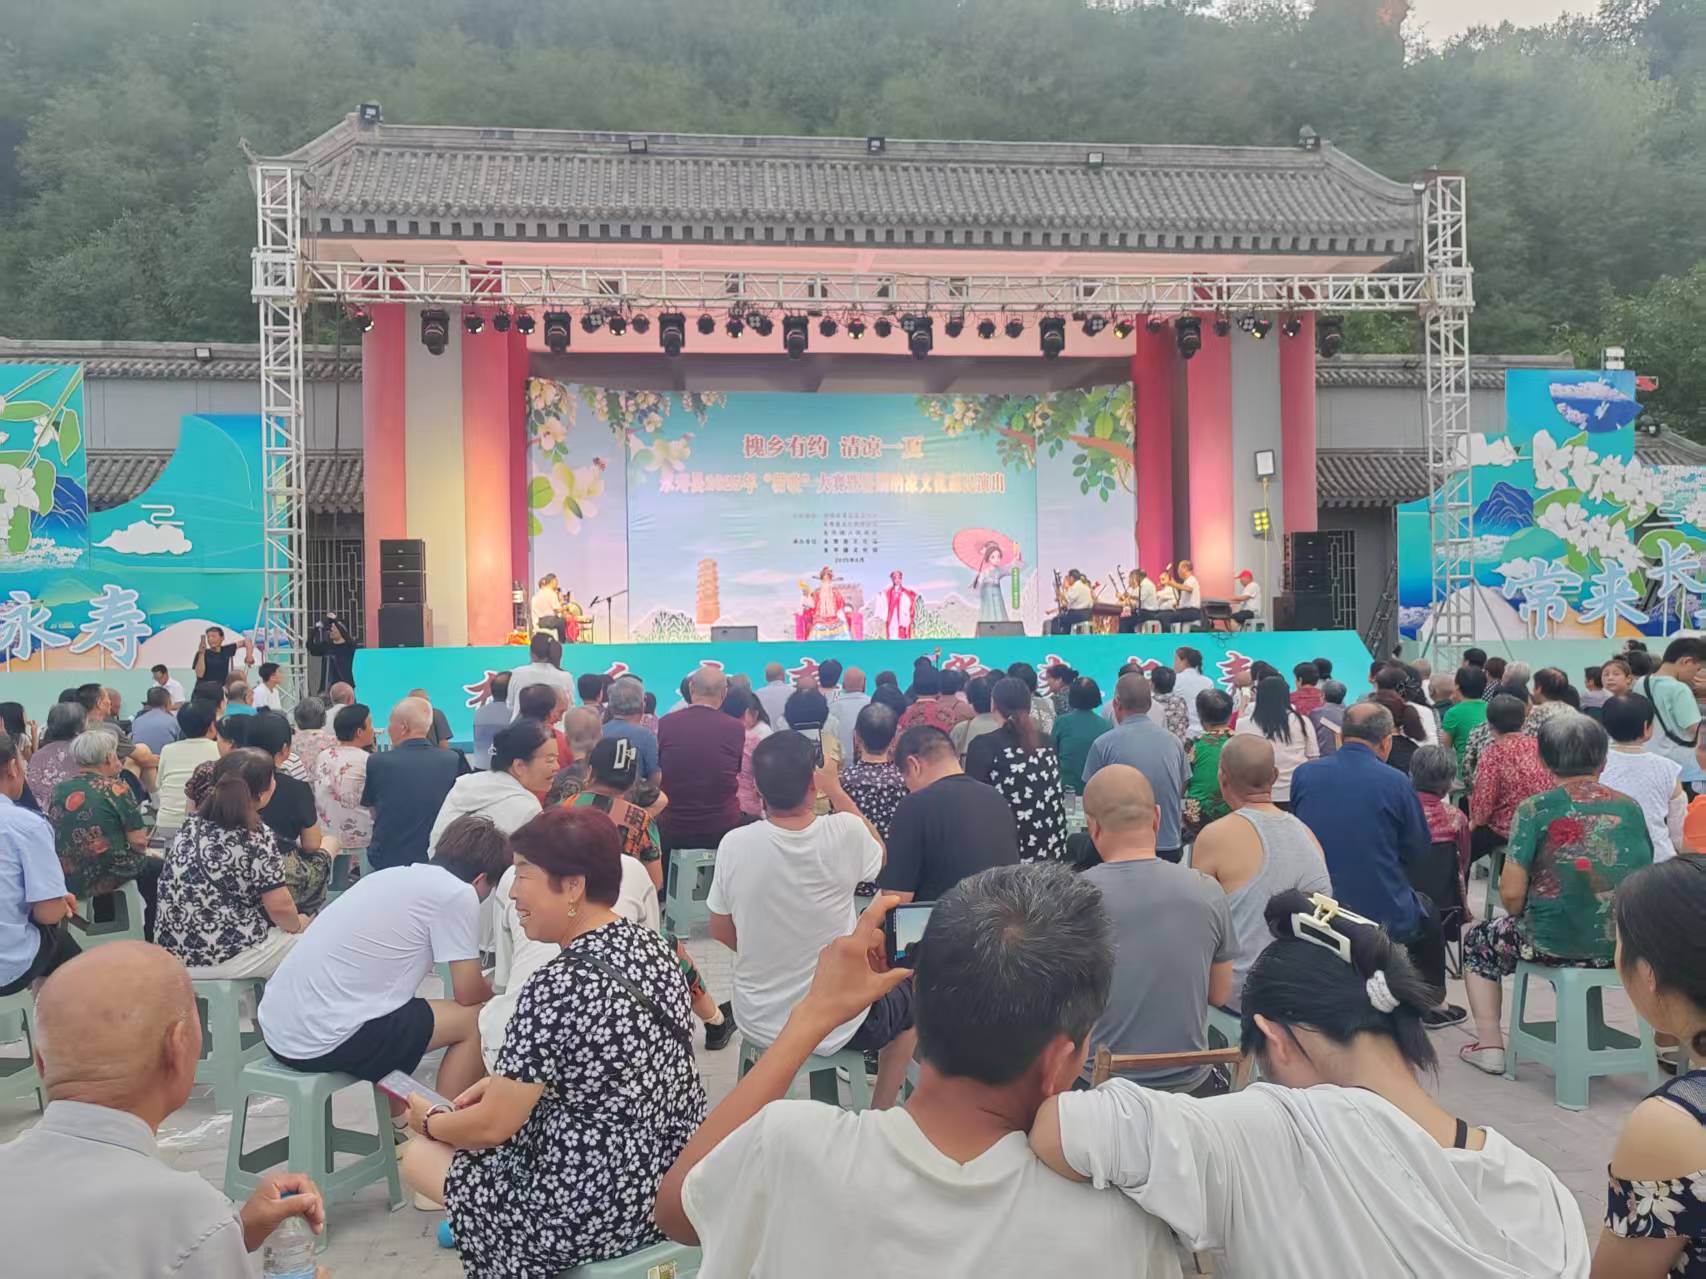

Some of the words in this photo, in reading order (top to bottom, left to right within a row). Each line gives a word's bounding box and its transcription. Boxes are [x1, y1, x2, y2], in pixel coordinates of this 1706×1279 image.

[744, 434, 829, 459] 槐乡有约
[0, 584, 152, 669] 永寿
